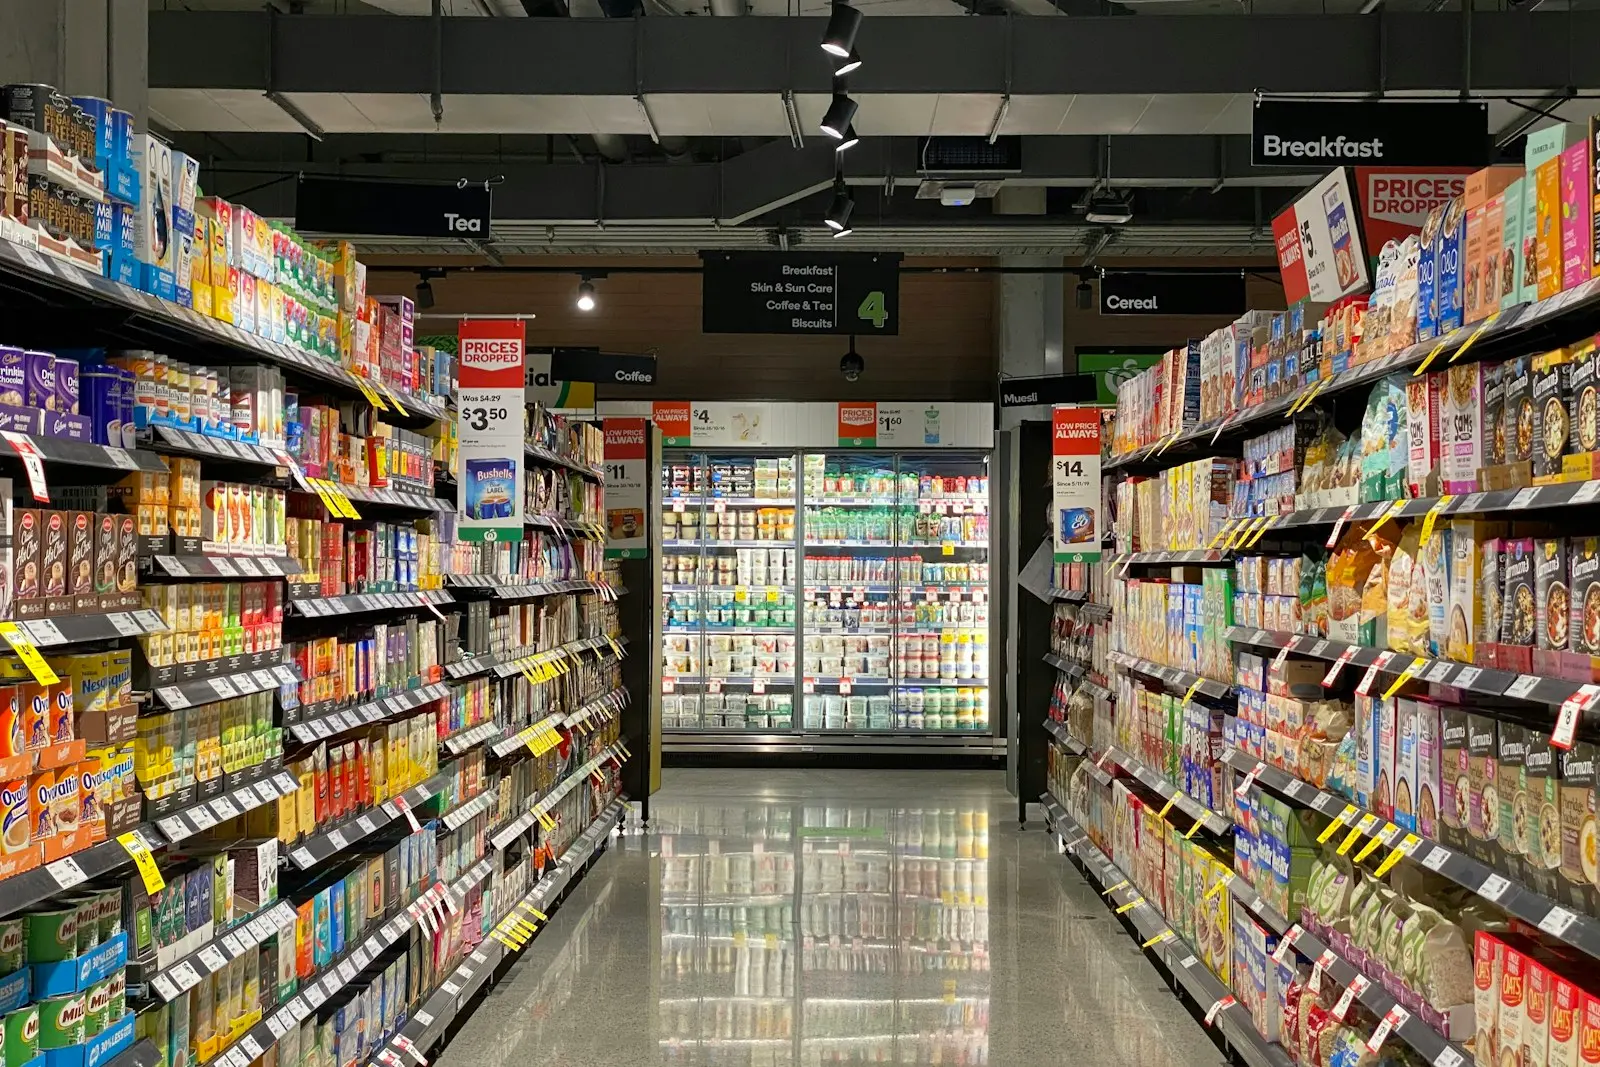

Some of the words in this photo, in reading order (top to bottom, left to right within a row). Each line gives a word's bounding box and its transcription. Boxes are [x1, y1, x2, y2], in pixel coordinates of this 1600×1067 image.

[1263, 135, 1384, 158] Breakfast
[1373, 179, 1465, 198] PRICES
[444, 213, 481, 232] Tea
[782, 265, 833, 276] Breakfast
[751, 283, 773, 294] Skin
[775, 284, 783, 293] &
[785, 283, 805, 293] Sun
[807, 283, 833, 293] Care
[766, 300, 800, 311] Coffee
[802, 301, 811, 311] &
[813, 301, 833, 311] Tea
[858, 291, 889, 328] 4
[1106, 295, 1158, 310] Cereal
[792, 318, 833, 329] Biscuits
[465, 342, 518, 353] PRICES
[465, 354, 518, 363] DROPPED
[615, 370, 652, 382] Coffee
[1004, 392, 1038, 404] Muesli
[693, 409, 709, 423] $4
[1075, 422, 1098, 430] PRICE
[605, 437, 644, 445] ALWAYS
[1056, 430, 1098, 439] ALWAYS
[477, 467, 513, 481] Bushells
[606, 464, 627, 480] $11
[1057, 461, 1083, 477] $14
[1476, 959, 1490, 980] OATS
[1504, 974, 1521, 996] OATS
[1557, 981, 1571, 998] UNCLE
[1529, 988, 1544, 1010] OATS
[1553, 1006, 1571, 1029] OATS
